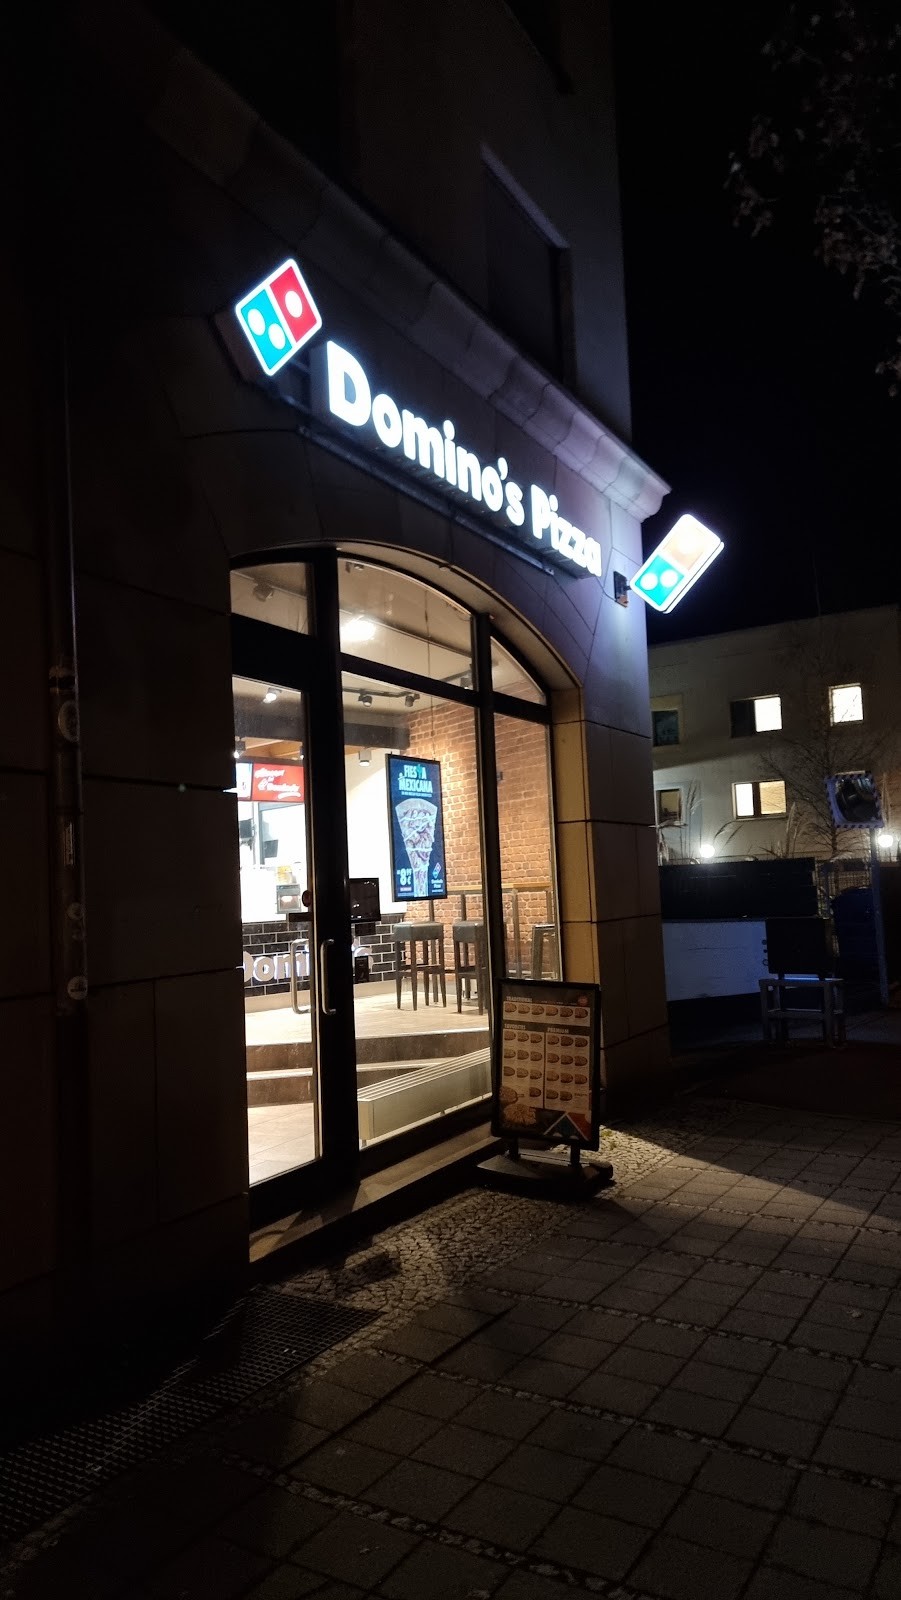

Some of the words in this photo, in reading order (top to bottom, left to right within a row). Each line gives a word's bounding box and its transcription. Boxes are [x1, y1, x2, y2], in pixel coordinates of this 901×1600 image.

[326, 340, 524, 527] Domino's
[530, 484, 602, 577] Pizza
[398, 777, 433, 794] MEXICANA
